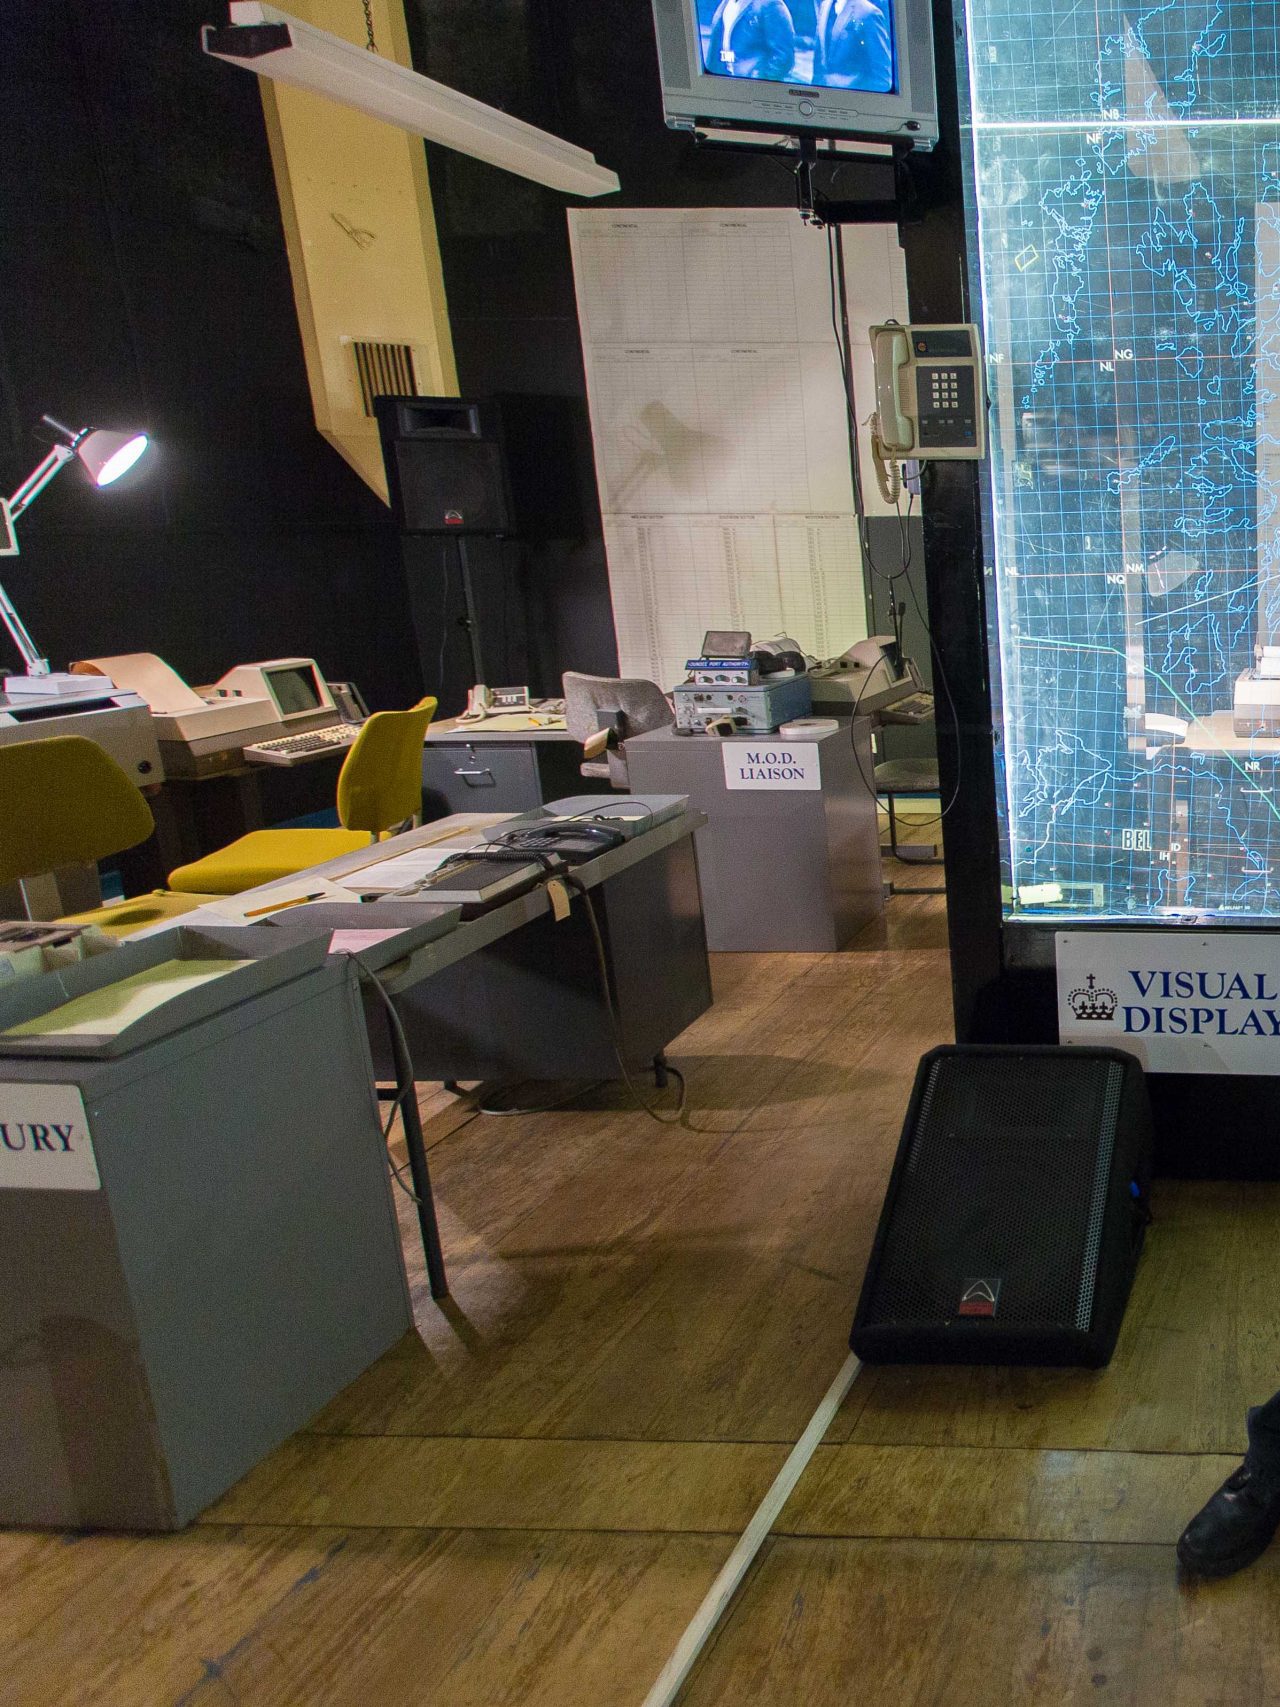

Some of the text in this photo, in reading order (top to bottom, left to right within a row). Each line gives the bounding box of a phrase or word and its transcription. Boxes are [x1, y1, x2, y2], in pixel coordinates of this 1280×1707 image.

[990, 354, 1004, 363] NF
[1115, 350, 1133, 359] NG
[1100, 363, 1114, 371] NL
[1127, 564, 1144, 573] NM
[1107, 575, 1125, 584] NQ
[747, 753, 796, 764] M.O.D.
[1245, 762, 1260, 770] NR
[740, 768, 804, 779] LIAISON
[1122, 829, 1151, 850] BEL
[1129, 971, 1278, 1000] VISUAL
